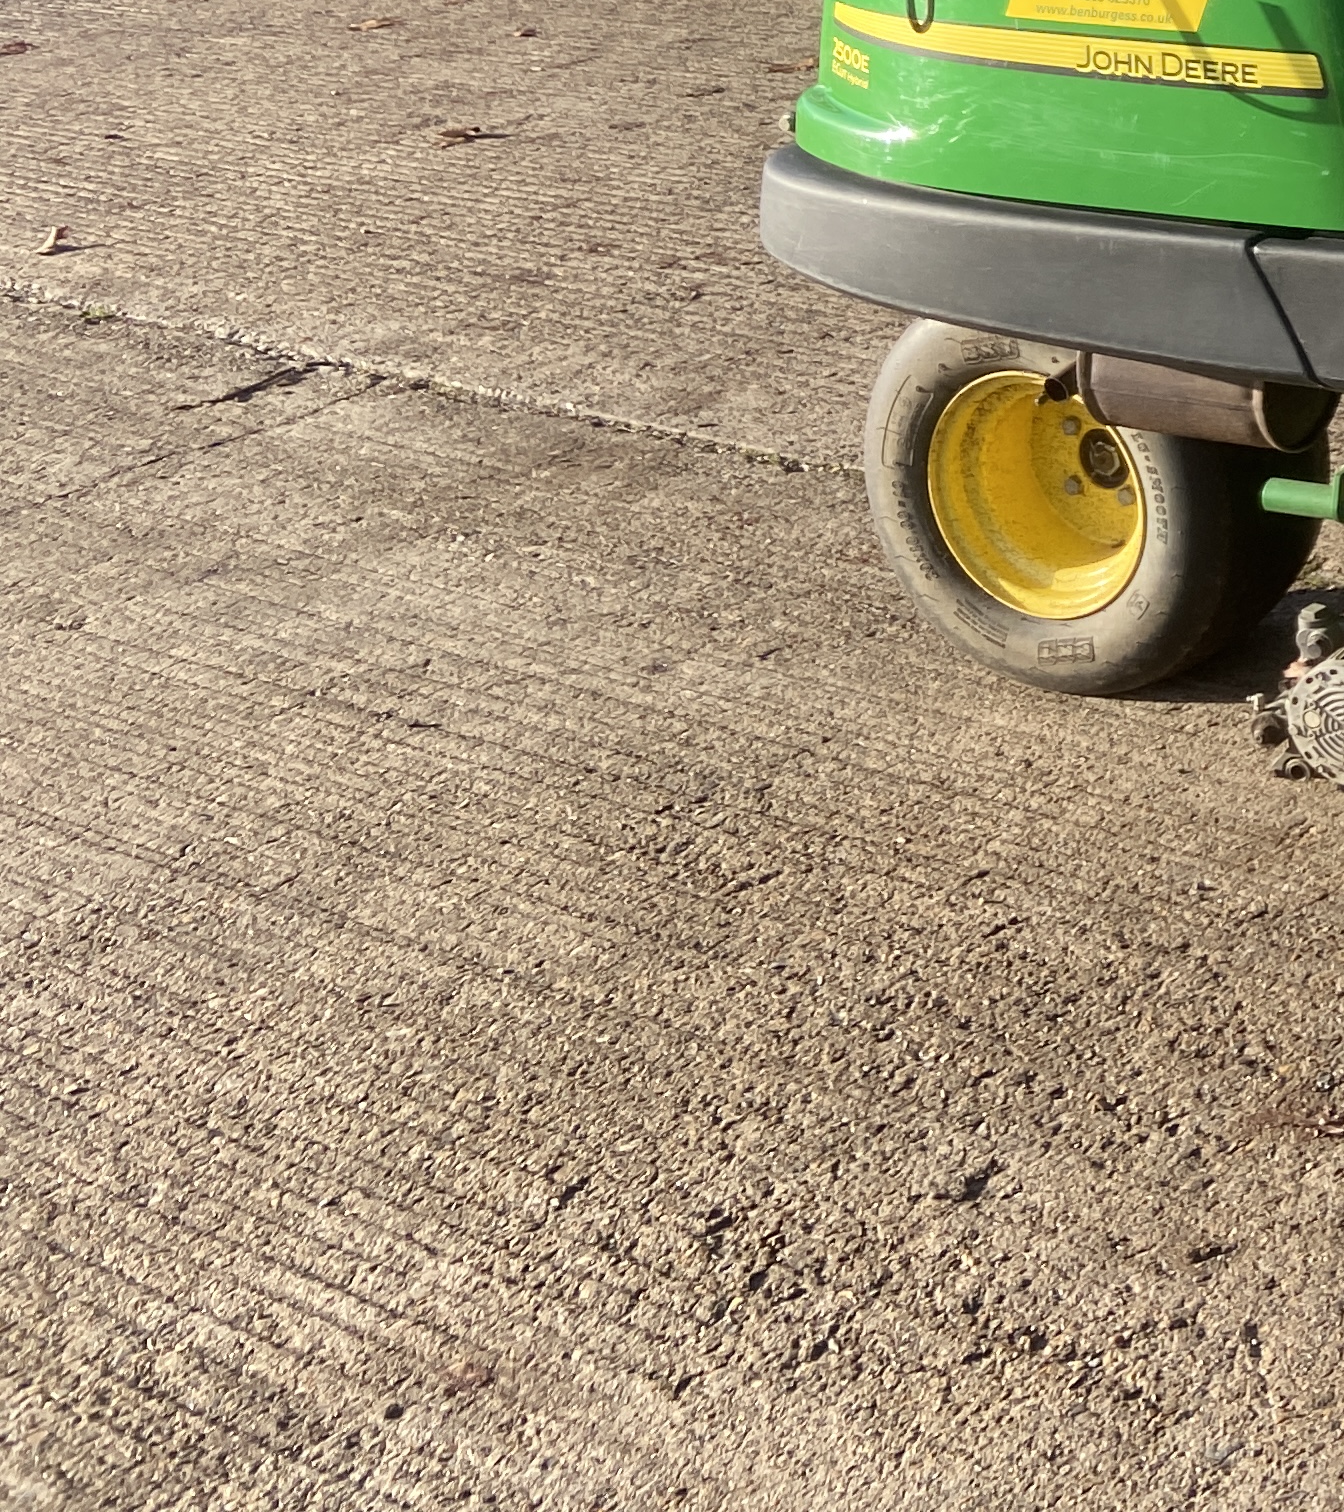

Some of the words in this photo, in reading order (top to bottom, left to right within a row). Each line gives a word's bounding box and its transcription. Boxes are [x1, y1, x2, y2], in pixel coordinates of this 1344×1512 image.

[1035, 2, 1174, 24] www.benburgess.co.uk
[832, 36, 870, 74] 2500E
[1075, 44, 1154, 75] JOHN
[1161, 51, 1259, 85] DEERE
